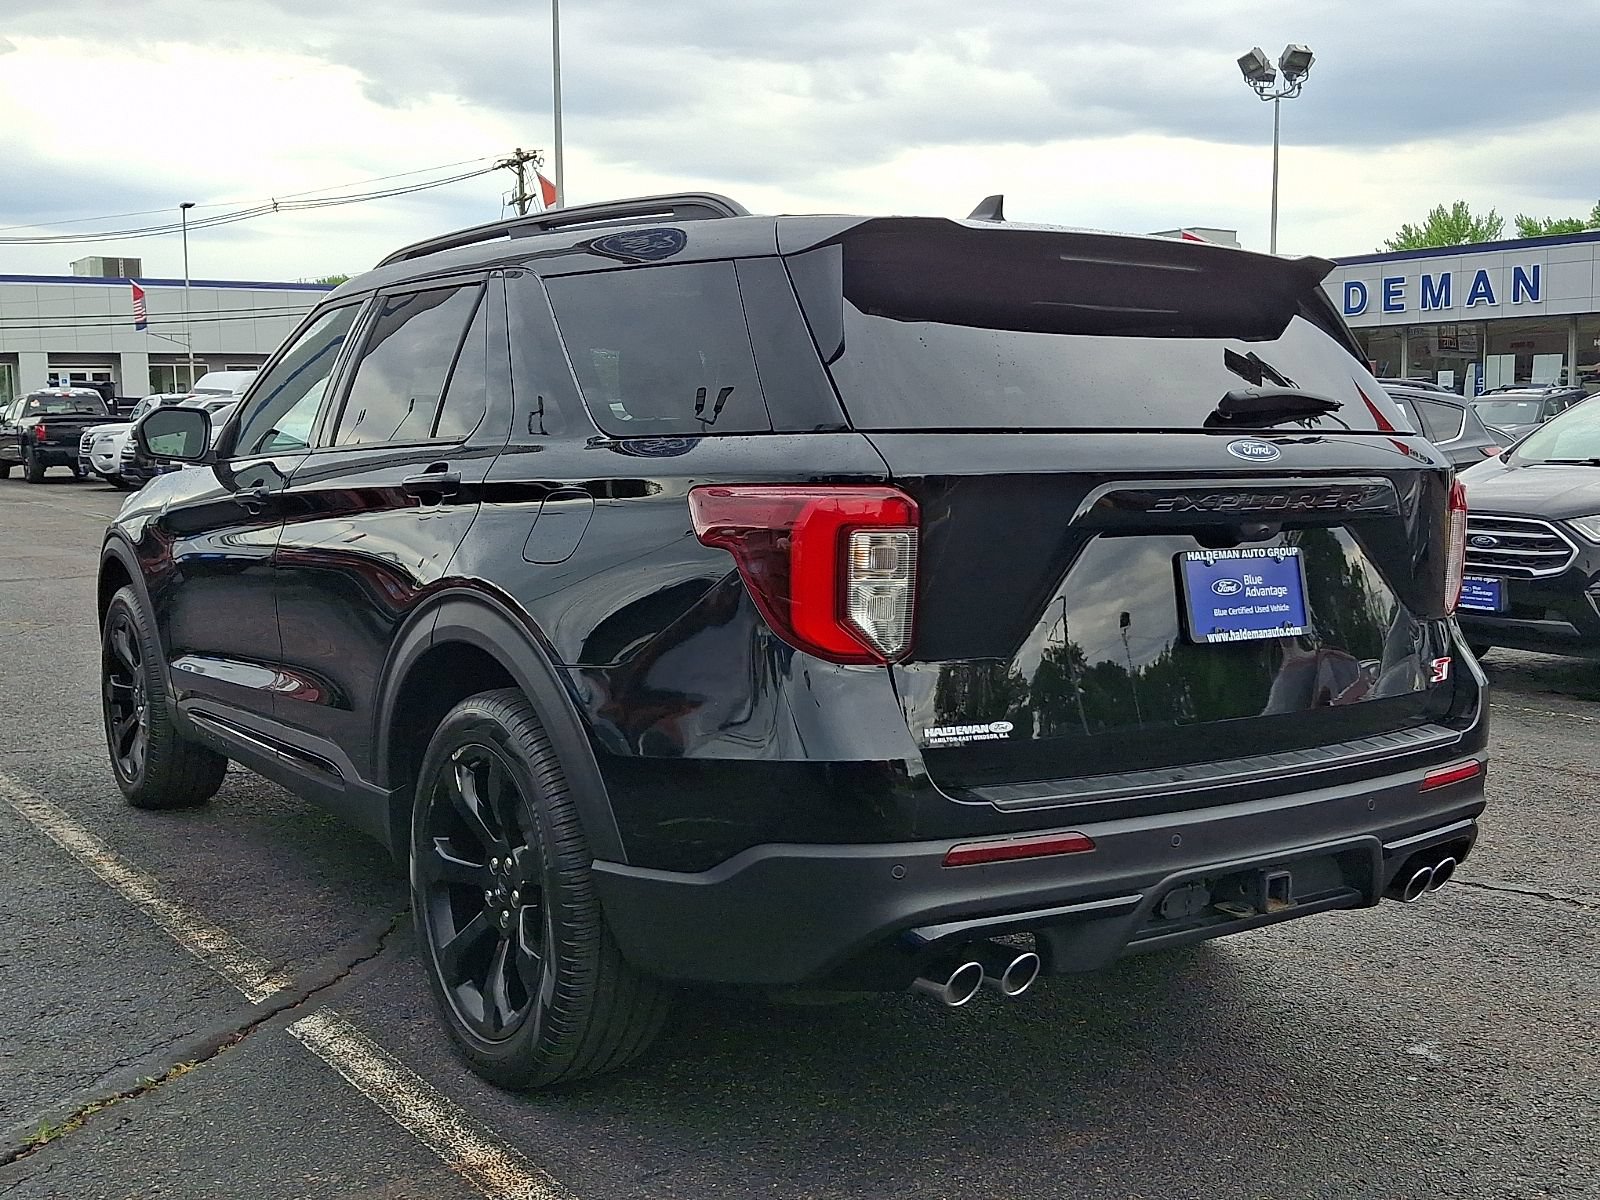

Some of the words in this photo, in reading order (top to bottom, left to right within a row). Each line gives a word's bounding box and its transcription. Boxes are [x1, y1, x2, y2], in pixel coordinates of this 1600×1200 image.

[1343, 264, 1542, 317] DEMAN
[1242, 442, 1272, 455] Ford
[1146, 490, 1368, 513] EXPLORER
[1187, 549, 1241, 561] HALDEMAN
[1241, 548, 1266, 559] AUTO
[1267, 547, 1298, 557] GROUP
[1243, 574, 1264, 585] Blue
[1216, 580, 1238, 593] Ford
[1245, 585, 1288, 598] Advantage
[1213, 608, 1228, 617] Blue
[1228, 605, 1254, 616] Certified
[1255, 605, 1270, 614] Used
[1270, 604, 1290, 613] Vehicle
[1207, 626, 1303, 643] www.haldemanauto.com
[924, 724, 989, 737] HALDEMAN
